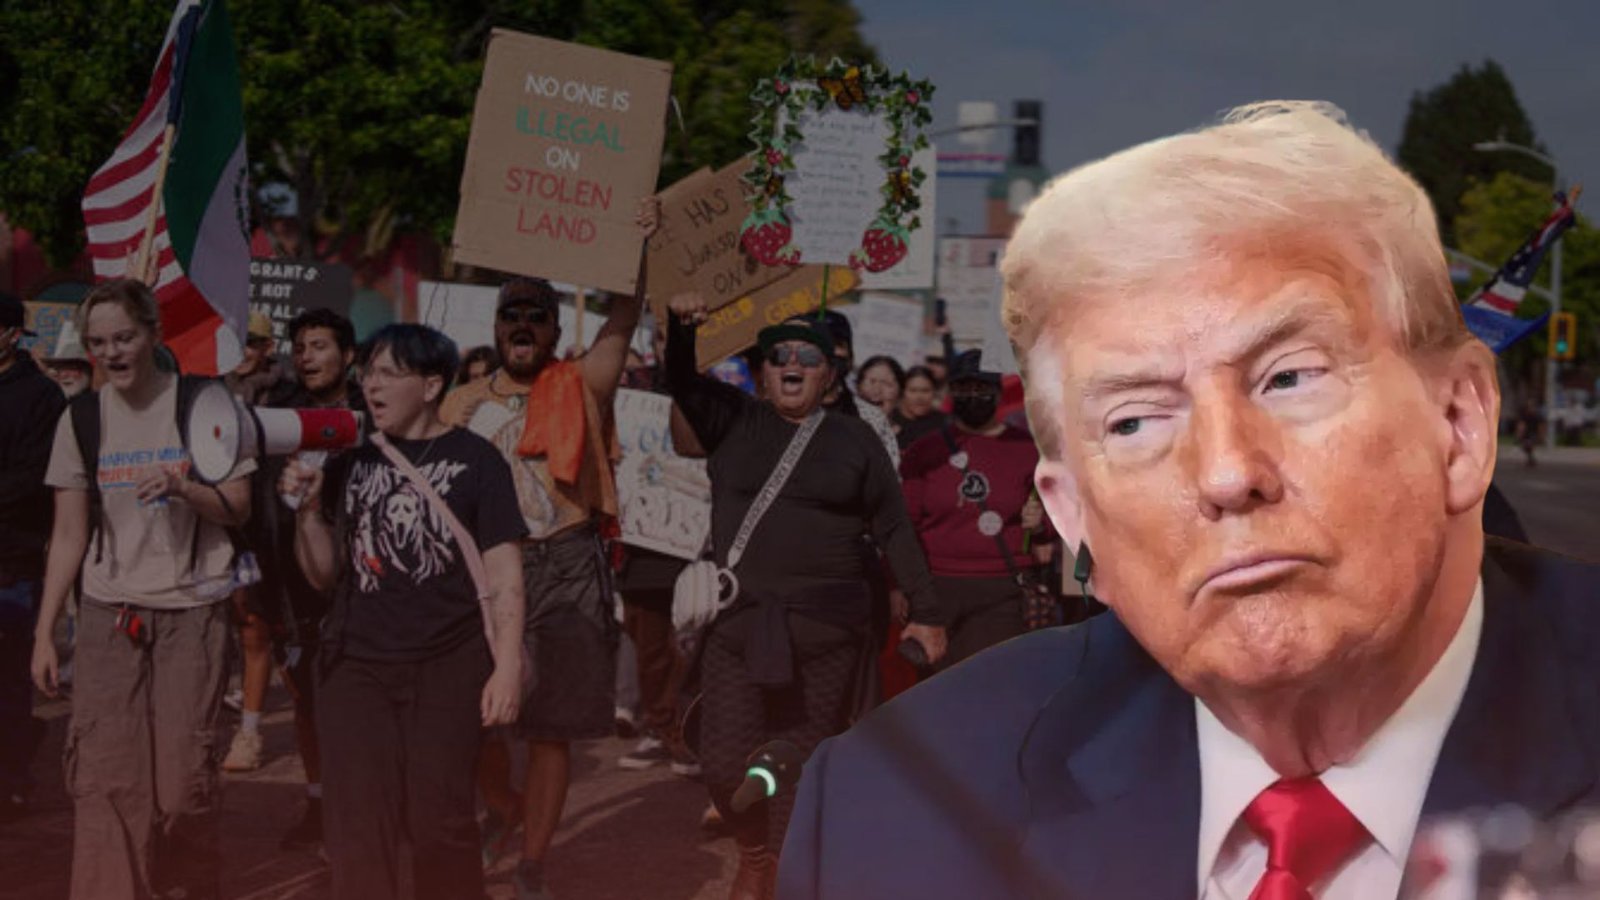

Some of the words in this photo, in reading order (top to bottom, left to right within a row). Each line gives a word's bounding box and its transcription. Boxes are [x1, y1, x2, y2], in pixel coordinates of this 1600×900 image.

[525, 73, 560, 97] NO
[562, 81, 608, 108] ONE
[612, 90, 630, 112] IS
[516, 106, 625, 153] ILLEGAL
[545, 145, 581, 171] ON
[505, 166, 612, 211] STOLEN
[516, 206, 597, 244] LAND
[684, 188, 729, 228] HAS
[250, 262, 317, 281] GRANTS
[713, 267, 741, 294] ON
[262, 284, 293, 298] NOT
